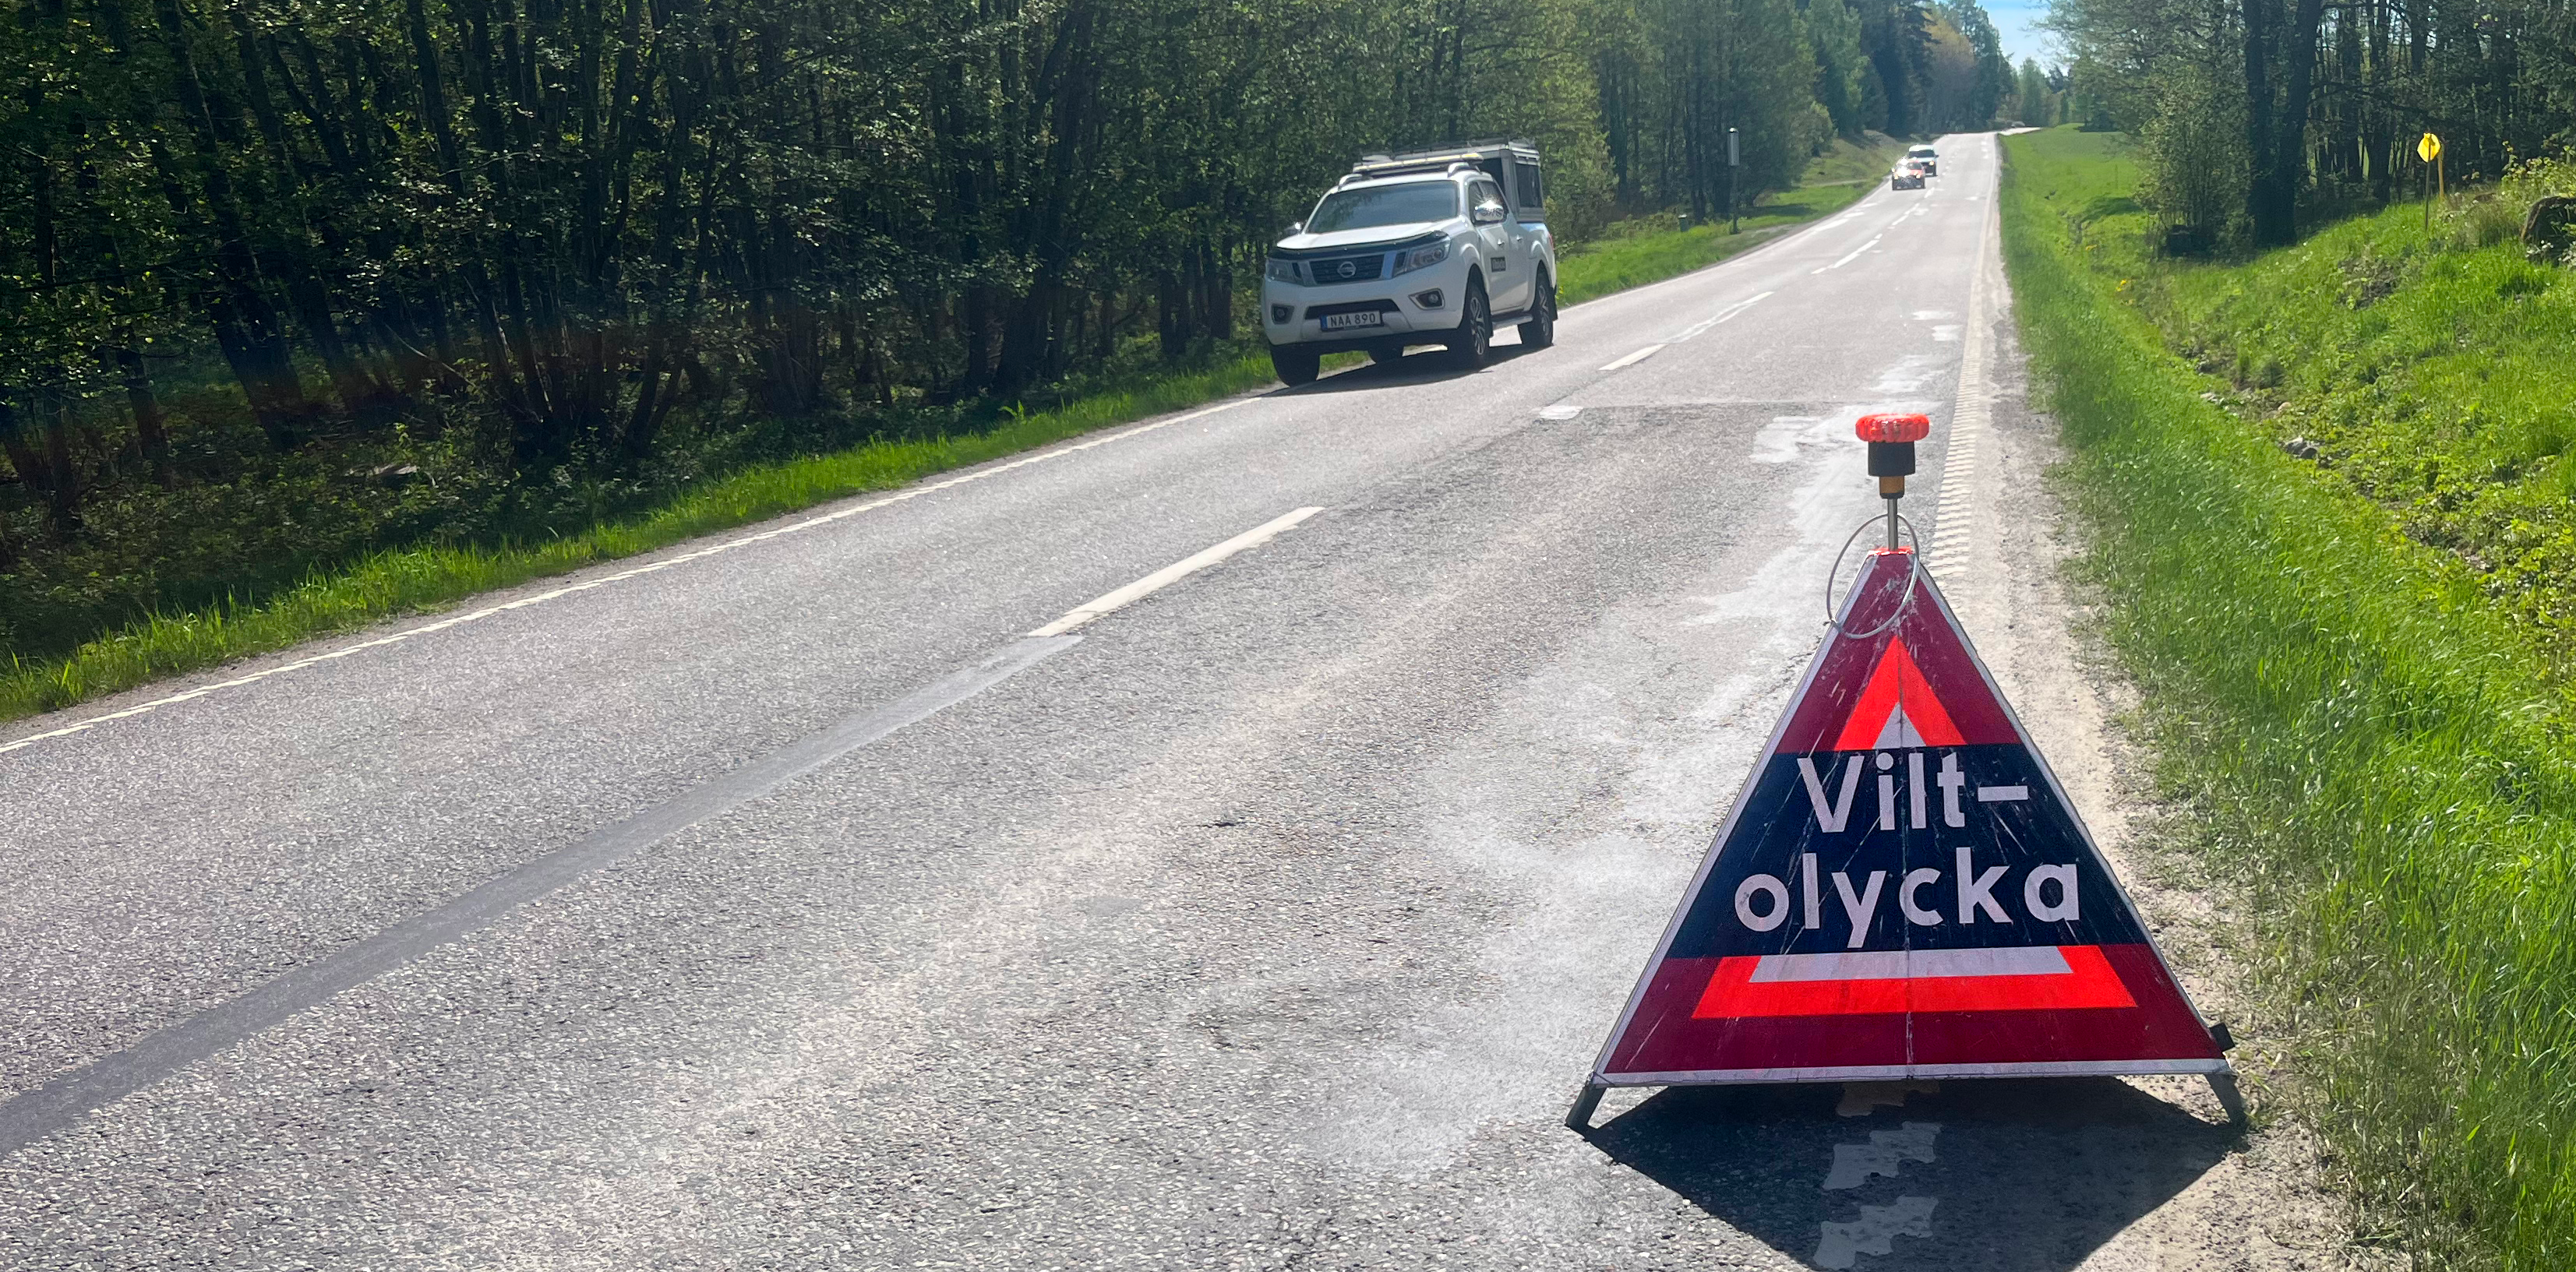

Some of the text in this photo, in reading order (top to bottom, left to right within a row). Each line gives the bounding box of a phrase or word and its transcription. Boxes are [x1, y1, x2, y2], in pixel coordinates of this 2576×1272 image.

[1330, 313, 1376, 326] NAA 890
[1797, 752, 2028, 833] Vilt-
[1734, 847, 2080, 949] olycka
